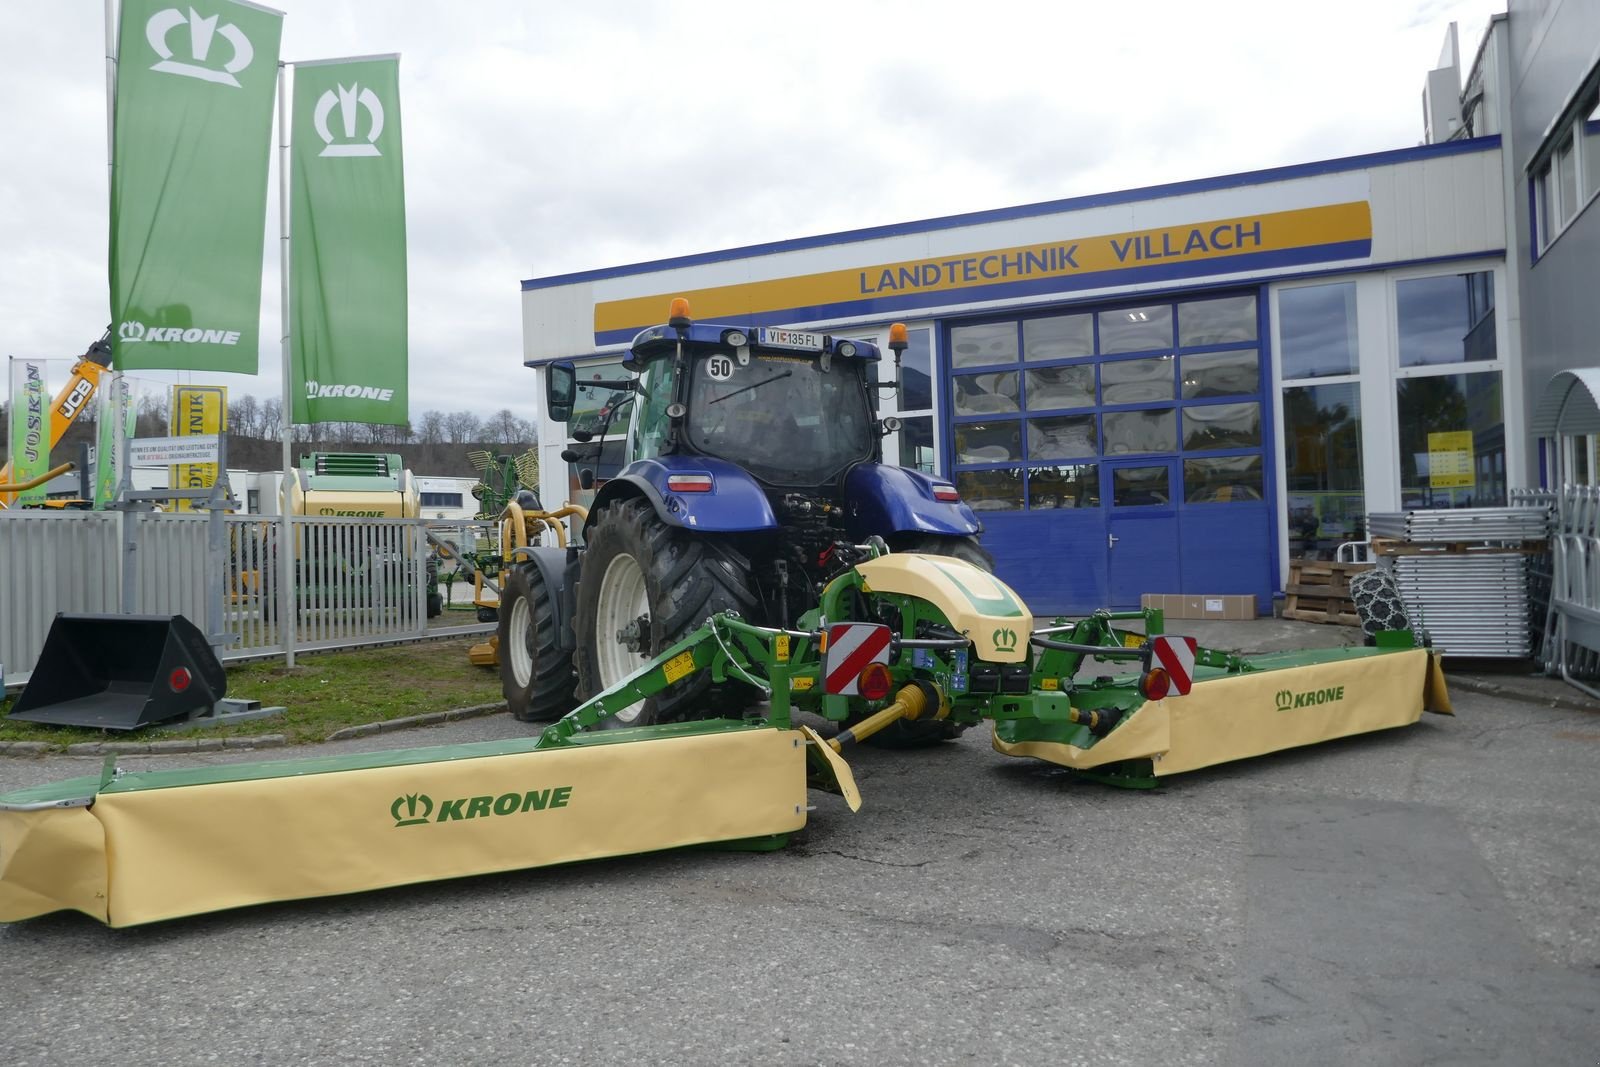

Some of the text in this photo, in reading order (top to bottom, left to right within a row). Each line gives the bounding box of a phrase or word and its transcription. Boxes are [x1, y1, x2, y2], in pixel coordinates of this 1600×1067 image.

[860, 221, 1261, 294] LANDTECHNIK VILLACH
[145, 327, 241, 345] KRONE
[787, 333, 804, 345] 135
[805, 335, 817, 347] FL
[710, 359, 731, 377] 50
[62, 379, 94, 419] JCB
[318, 384, 394, 401] KRONE
[25, 362, 42, 463] JOSKIN
[336, 510, 385, 518] KRONE
[1294, 685, 1345, 709] KRONE
[436, 786, 573, 823] KRONE
